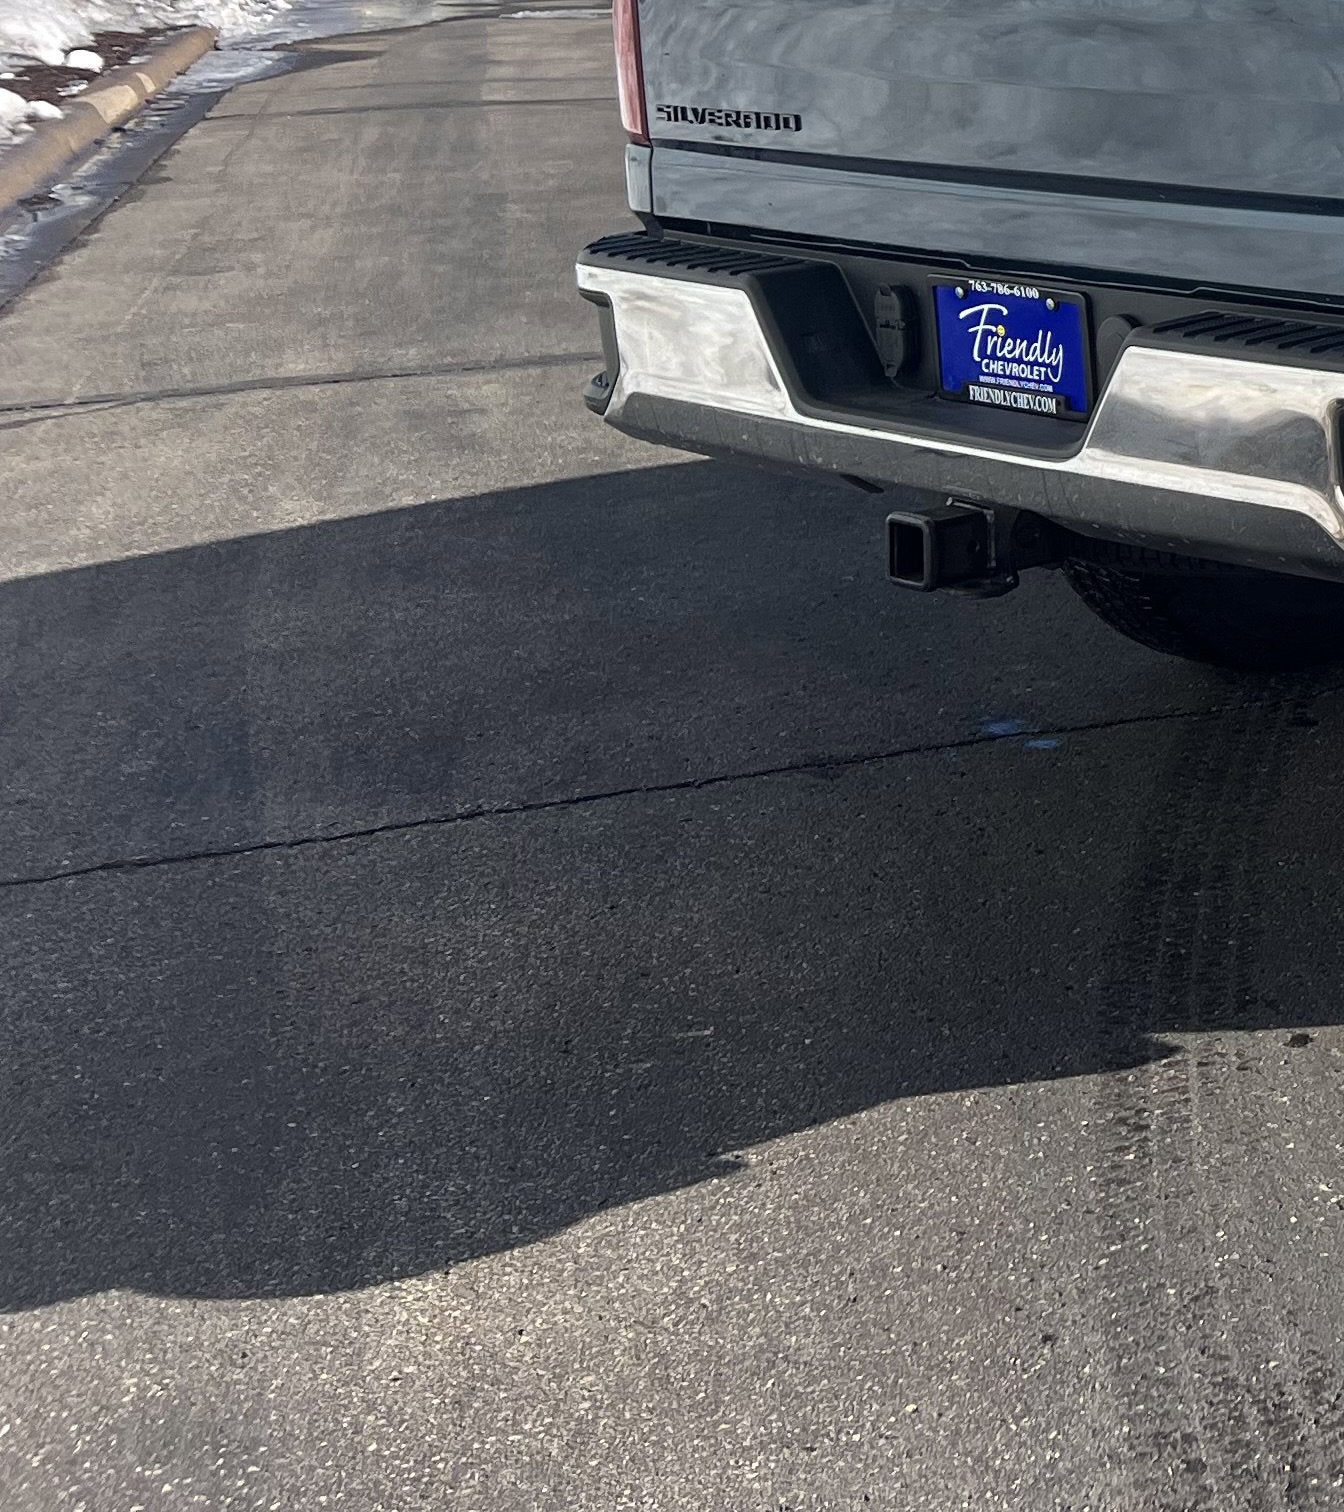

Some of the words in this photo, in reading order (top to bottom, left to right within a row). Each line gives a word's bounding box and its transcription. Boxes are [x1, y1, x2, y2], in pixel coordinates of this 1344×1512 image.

[655, 104, 803, 132] SILVERADO
[968, 279, 1040, 299] 763-786-6100
[959, 303, 1064, 383] Friendly
[981, 358, 1047, 381] CHEVROLET
[968, 384, 1058, 415] FRIENDLYCHEV.COM
